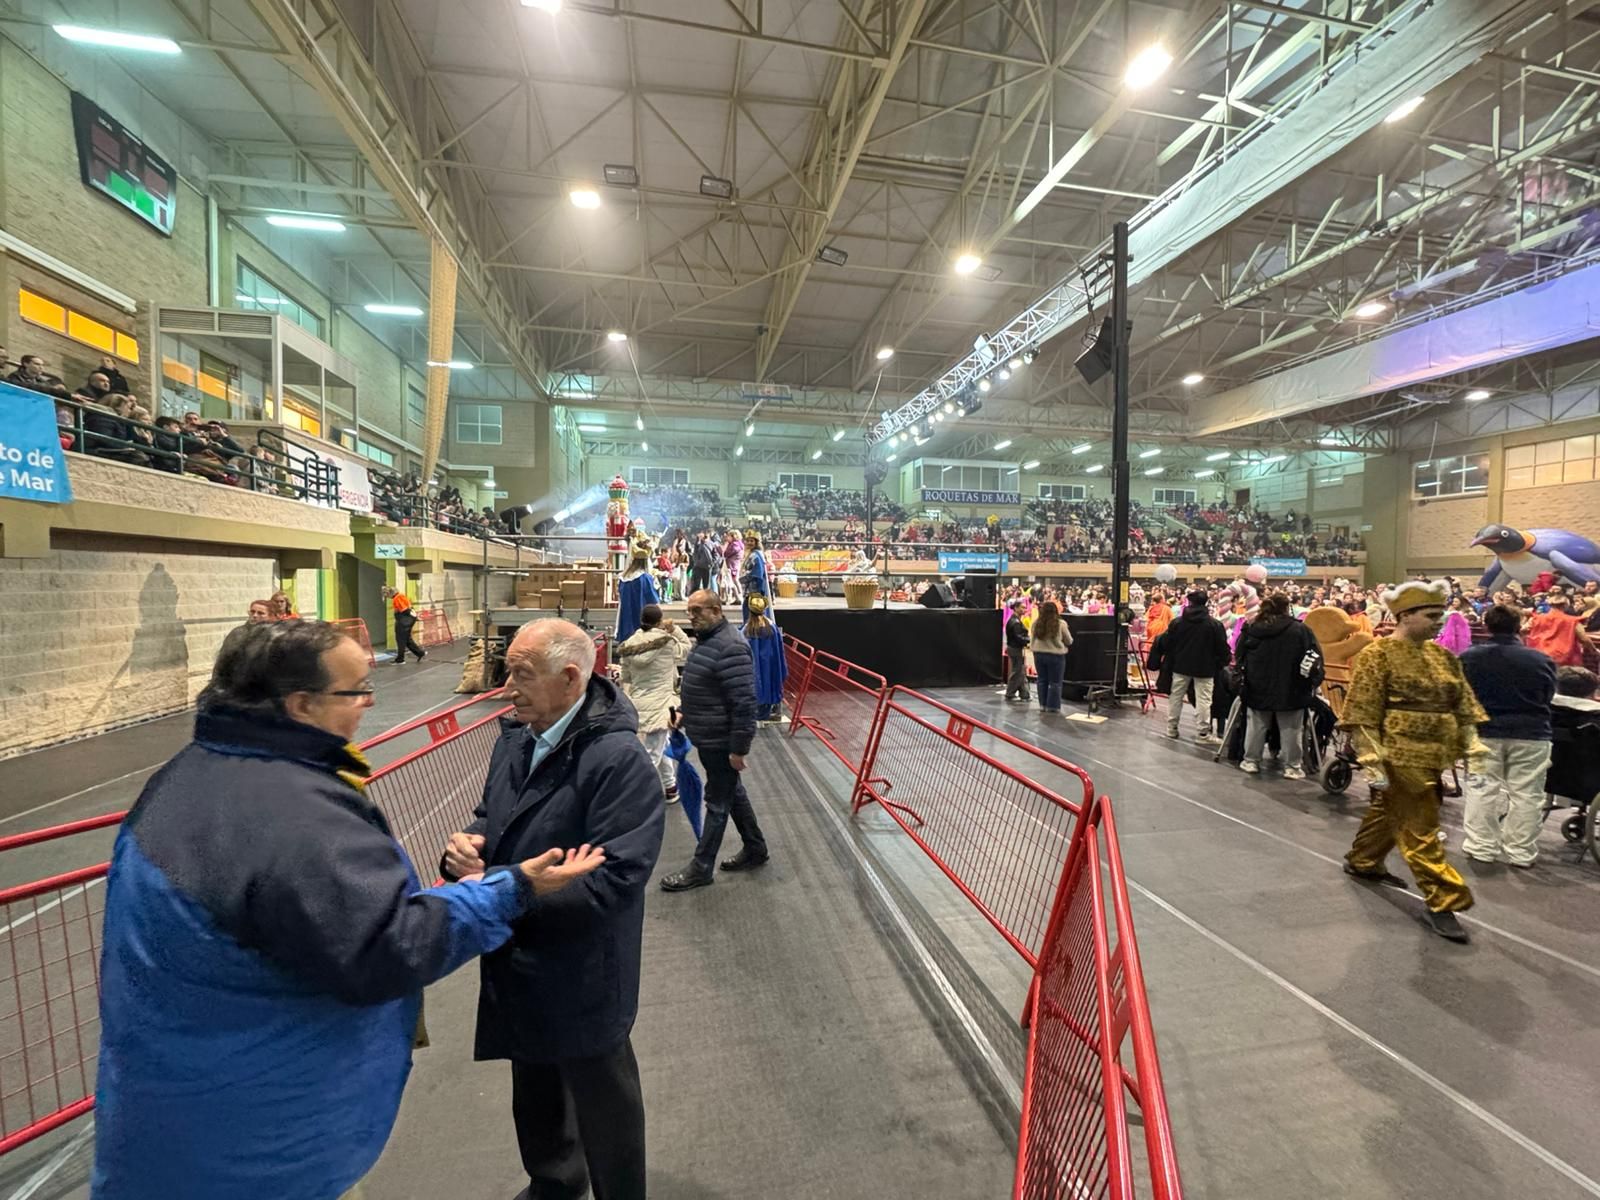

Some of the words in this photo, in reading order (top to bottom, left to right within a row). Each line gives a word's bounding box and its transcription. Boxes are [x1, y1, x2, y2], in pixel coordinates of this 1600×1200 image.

[27, 448, 54, 469] de
[11, 469, 54, 492] Mar
[925, 490, 979, 503] ROQUETAS
[982, 494, 993, 503] DE
[996, 494, 1018, 504] MAR
